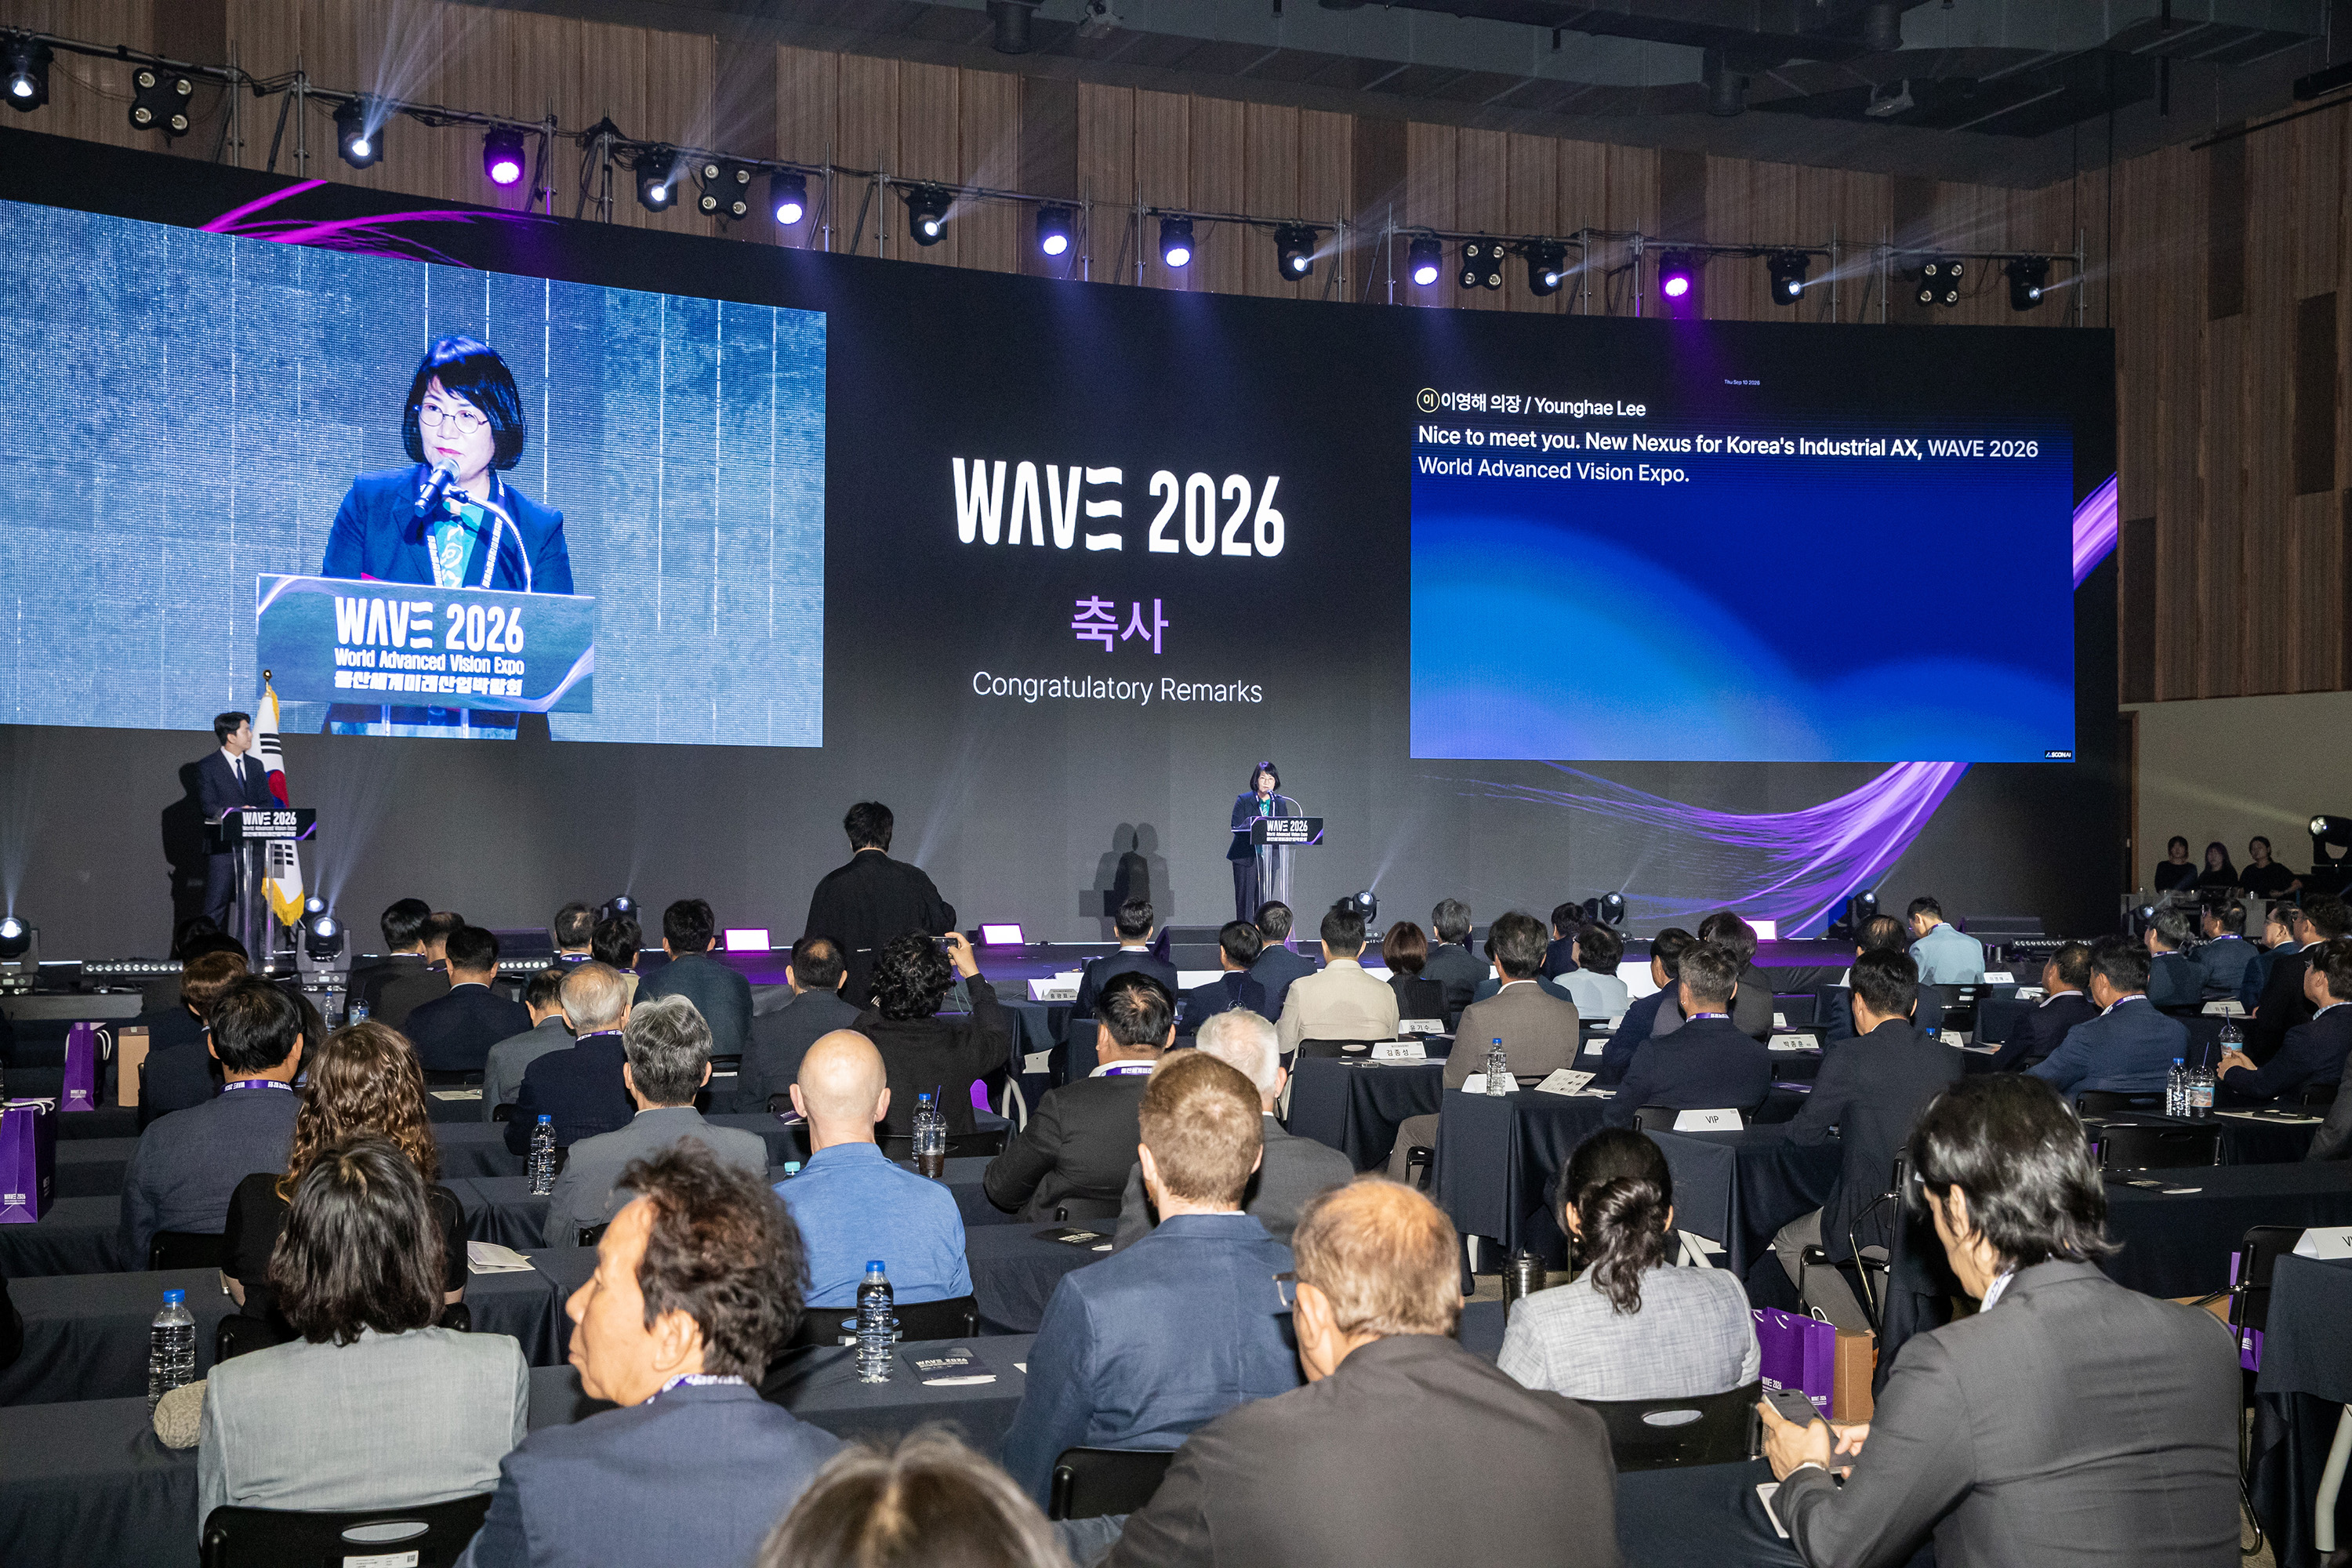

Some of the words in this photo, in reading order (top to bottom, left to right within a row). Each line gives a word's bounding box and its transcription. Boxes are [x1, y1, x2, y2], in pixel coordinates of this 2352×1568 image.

[1441, 392, 1486, 412] 이영해
[1490, 394, 1521, 414] 의장
[1524, 396, 1531, 414] /
[1534, 397, 1613, 418] Younghae
[1617, 401, 1646, 416] Lee
[1418, 425, 1461, 445] Nice
[1466, 428, 1484, 445] to
[1490, 430, 1537, 448] meet
[1541, 434, 1581, 452] you.
[1586, 432, 1628, 450] New
[1632, 434, 1691, 452] Nexus
[1696, 434, 1722, 452] for
[1727, 436, 1795, 455] Korea's
[1799, 437, 1886, 456] Industrial
[1890, 439, 1922, 460] AX,
[1928, 439, 1984, 457] WAVE
[1989, 440, 2038, 458] 2026
[1418, 456, 1472, 476] World
[1478, 459, 1570, 479] Advanced
[1577, 462, 1633, 481] Vision
[1639, 464, 1690, 485] Expo.
[953, 457, 1122, 550] WAVE
[1149, 470, 1284, 557] 2026
[335, 597, 433, 648] WAVE
[446, 603, 524, 653] 2026
[1071, 596, 1169, 654] 축사
[334, 648, 375, 667] World
[379, 650, 445, 671] Advanced
[450, 654, 491, 673] Vision
[494, 656, 524, 676] Expo
[972, 671, 1153, 706] Congratulatory
[1161, 677, 1262, 703] Remarks
[242, 811, 270, 825] WAVE
[273, 811, 297, 826] 2026
[1267, 820, 1288, 832] WAVE
[1290, 820, 1308, 832] 2026
[2341, 1236, 2352, 1247] V
